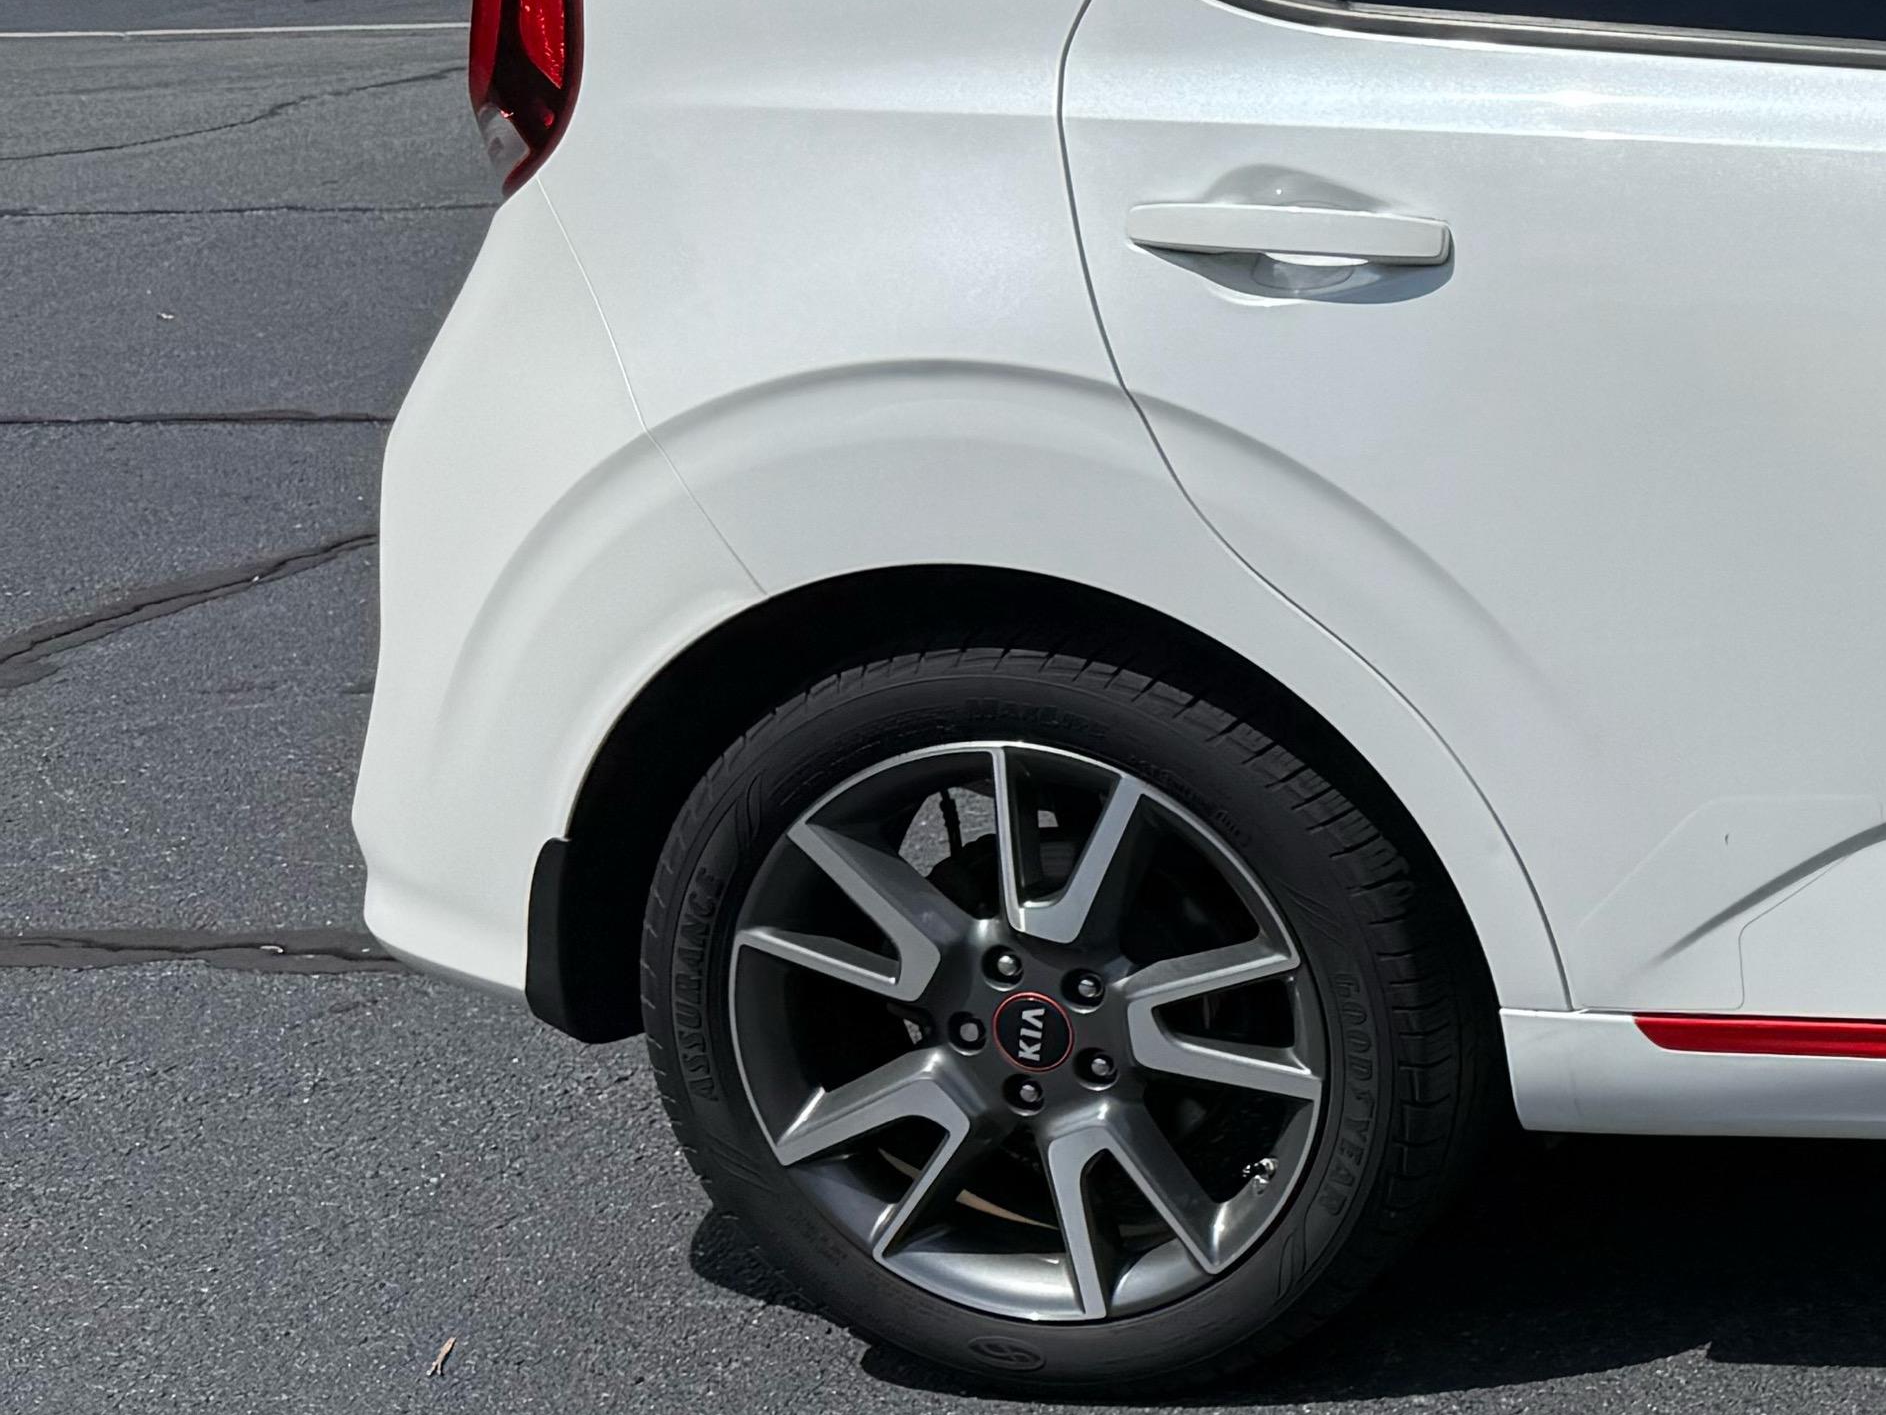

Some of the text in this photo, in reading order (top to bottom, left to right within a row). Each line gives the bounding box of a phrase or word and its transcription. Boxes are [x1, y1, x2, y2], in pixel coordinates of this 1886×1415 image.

[682, 868, 729, 1102] ASSURANCE
[1017, 1006, 1046, 1063] KIA
[1334, 973, 1379, 1219] GOODYEAR
